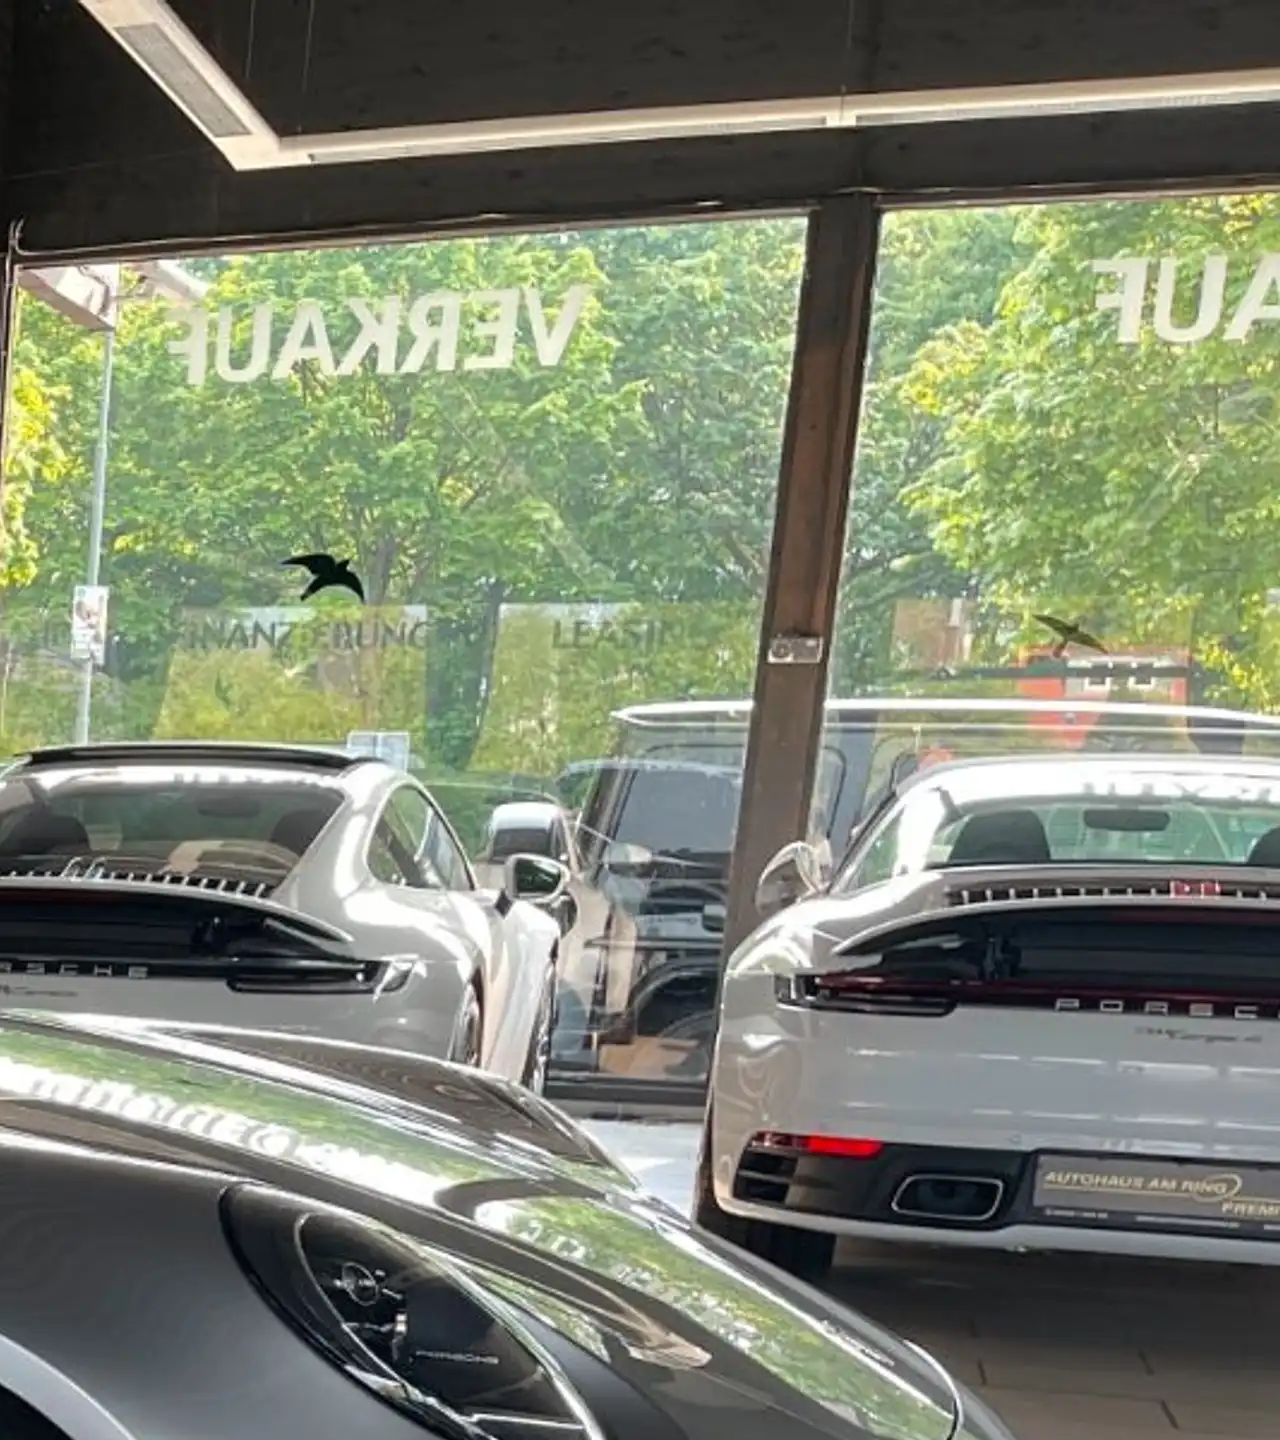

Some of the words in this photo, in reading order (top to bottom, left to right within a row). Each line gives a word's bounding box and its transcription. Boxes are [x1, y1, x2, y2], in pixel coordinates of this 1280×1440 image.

[1055, 998, 1280, 1019] PORSC
[1043, 1171, 1144, 1189] AUTOHAUS
[1147, 1176, 1177, 1190] AM
[1181, 1180, 1229, 1195] RING
